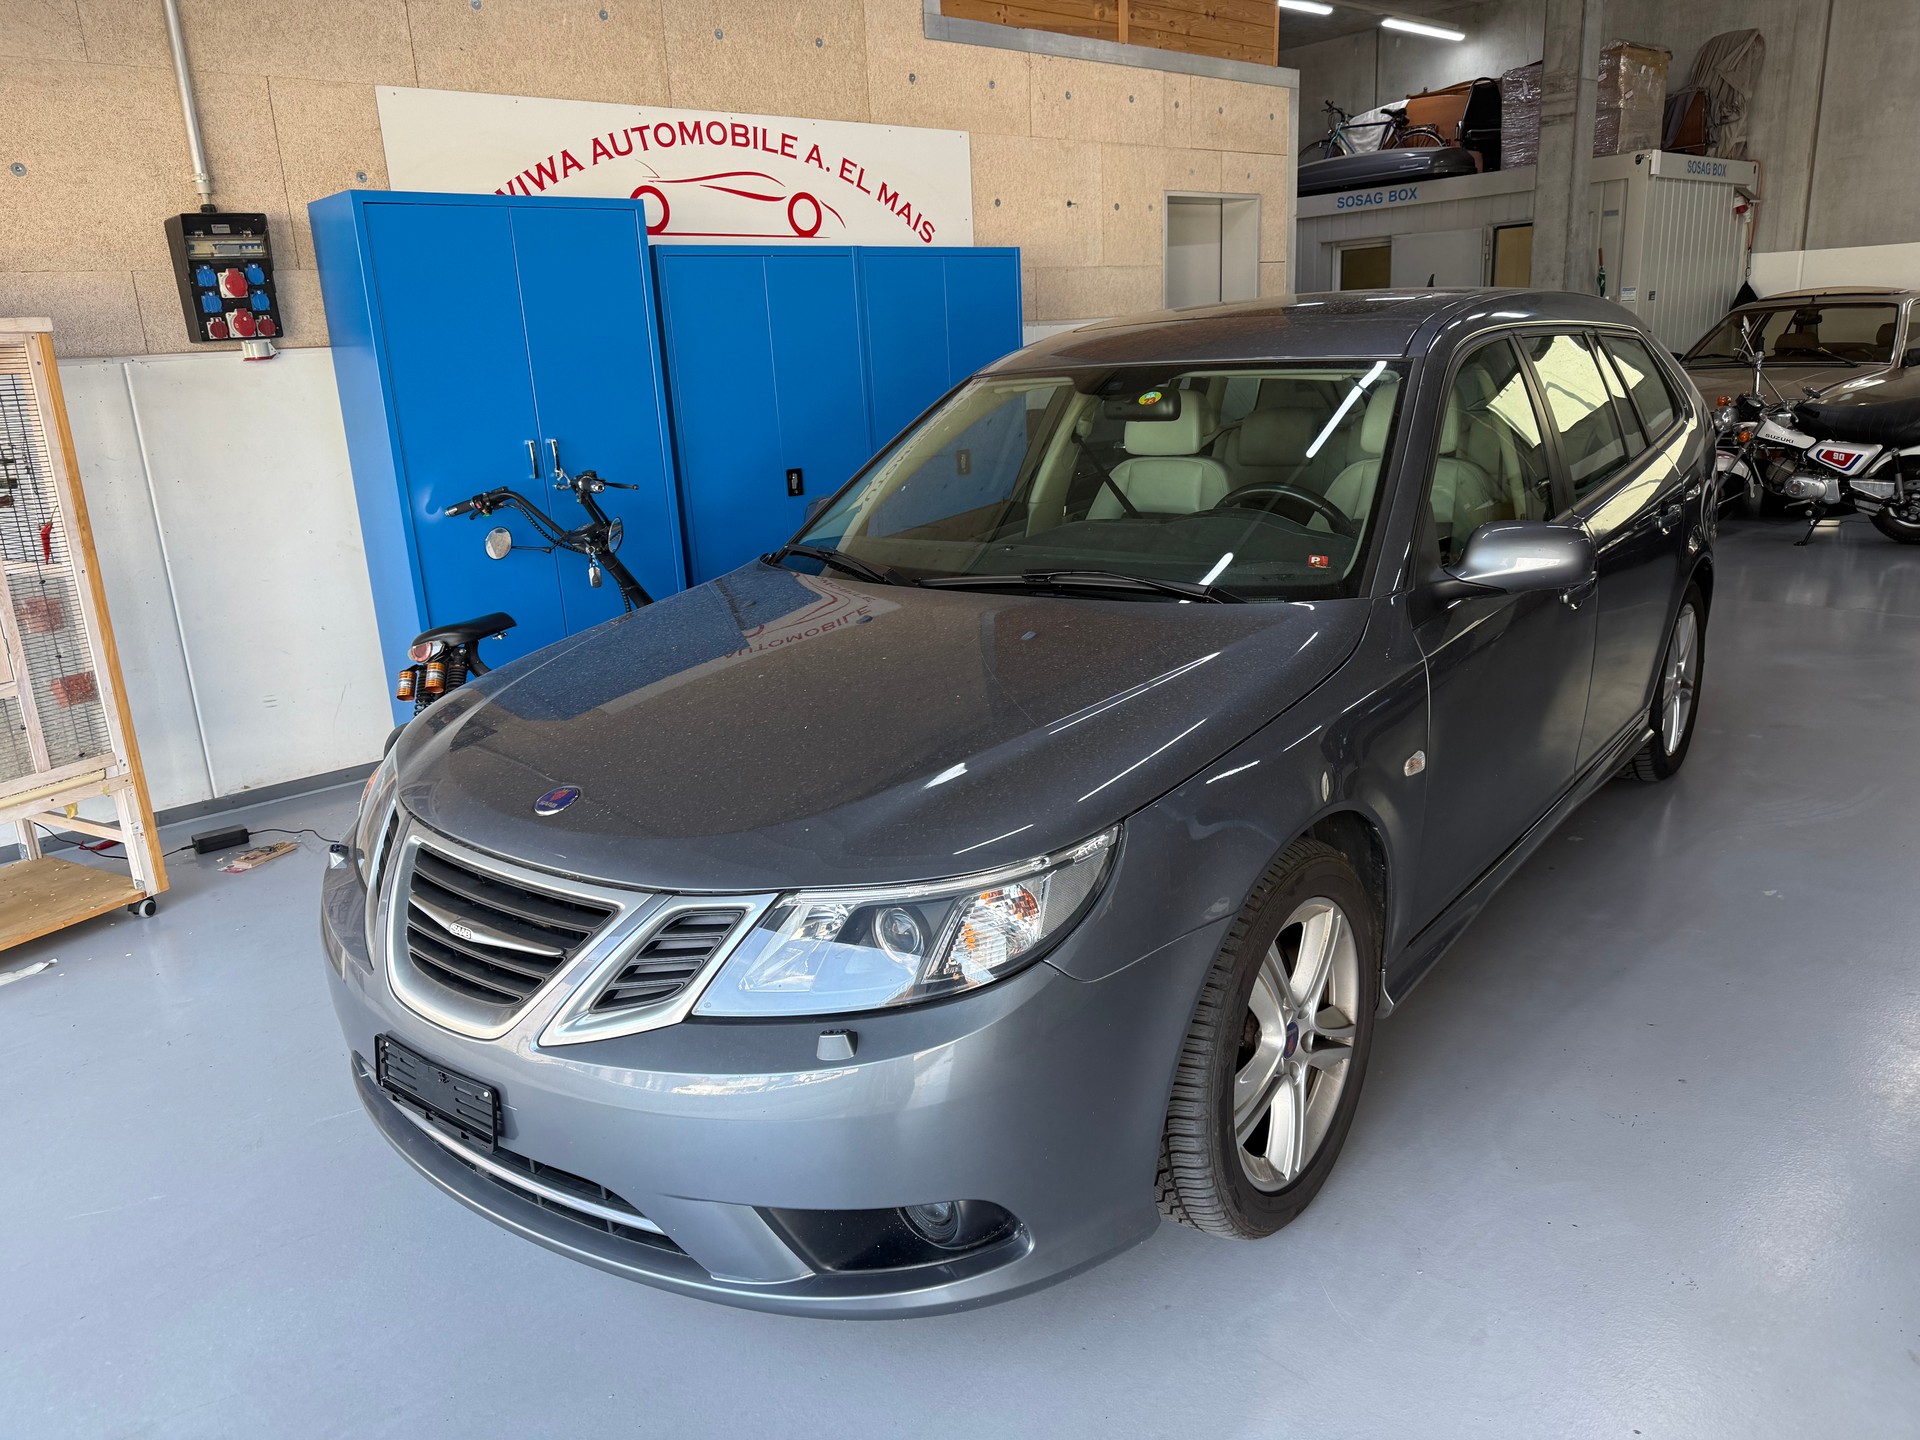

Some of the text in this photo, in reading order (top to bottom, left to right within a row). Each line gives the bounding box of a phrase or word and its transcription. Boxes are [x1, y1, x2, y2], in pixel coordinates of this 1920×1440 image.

[1687, 160, 1727, 177] SOSAG BOX
[592, 121, 798, 166] AUTOMOBILE
[804, 143, 831, 173] A.
[838, 157, 871, 195] EL
[876, 181, 936, 244] MAIS
[1337, 187, 1417, 208] SOSAG BOX
[1765, 433, 1794, 444] SUZUKI
[1832, 452, 1845, 461] 90
